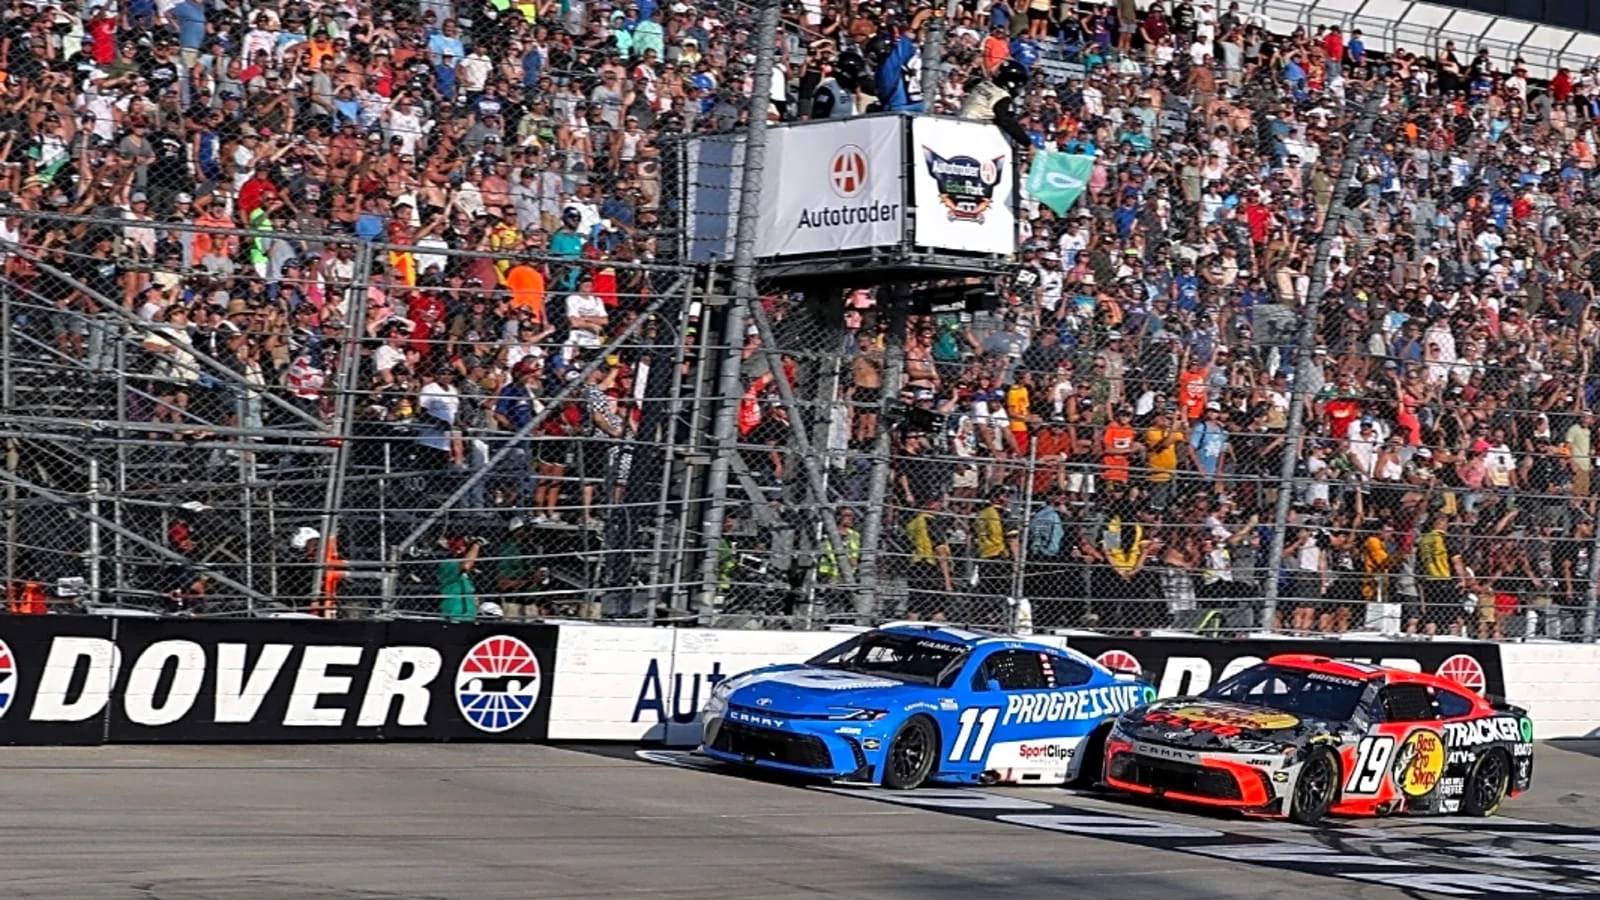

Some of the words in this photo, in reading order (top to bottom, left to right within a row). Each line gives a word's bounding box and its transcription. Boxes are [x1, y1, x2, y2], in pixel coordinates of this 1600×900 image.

[797, 199, 899, 229] Autotrader
[916, 640, 966, 653] HAMLIN
[29, 636, 442, 726] DOVER
[1307, 672, 1361, 687] BRISCOE
[1001, 686, 1140, 726] PROGRESSIVE
[730, 711, 785, 728] CAMRY
[949, 707, 1000, 762] 11
[1443, 716, 1521, 748] TRACKER
[1019, 744, 1075, 761] SportClips
[1138, 745, 1197, 760] CAMRY
[1447, 751, 1477, 765] ATVs
[1345, 736, 1395, 793] 19
